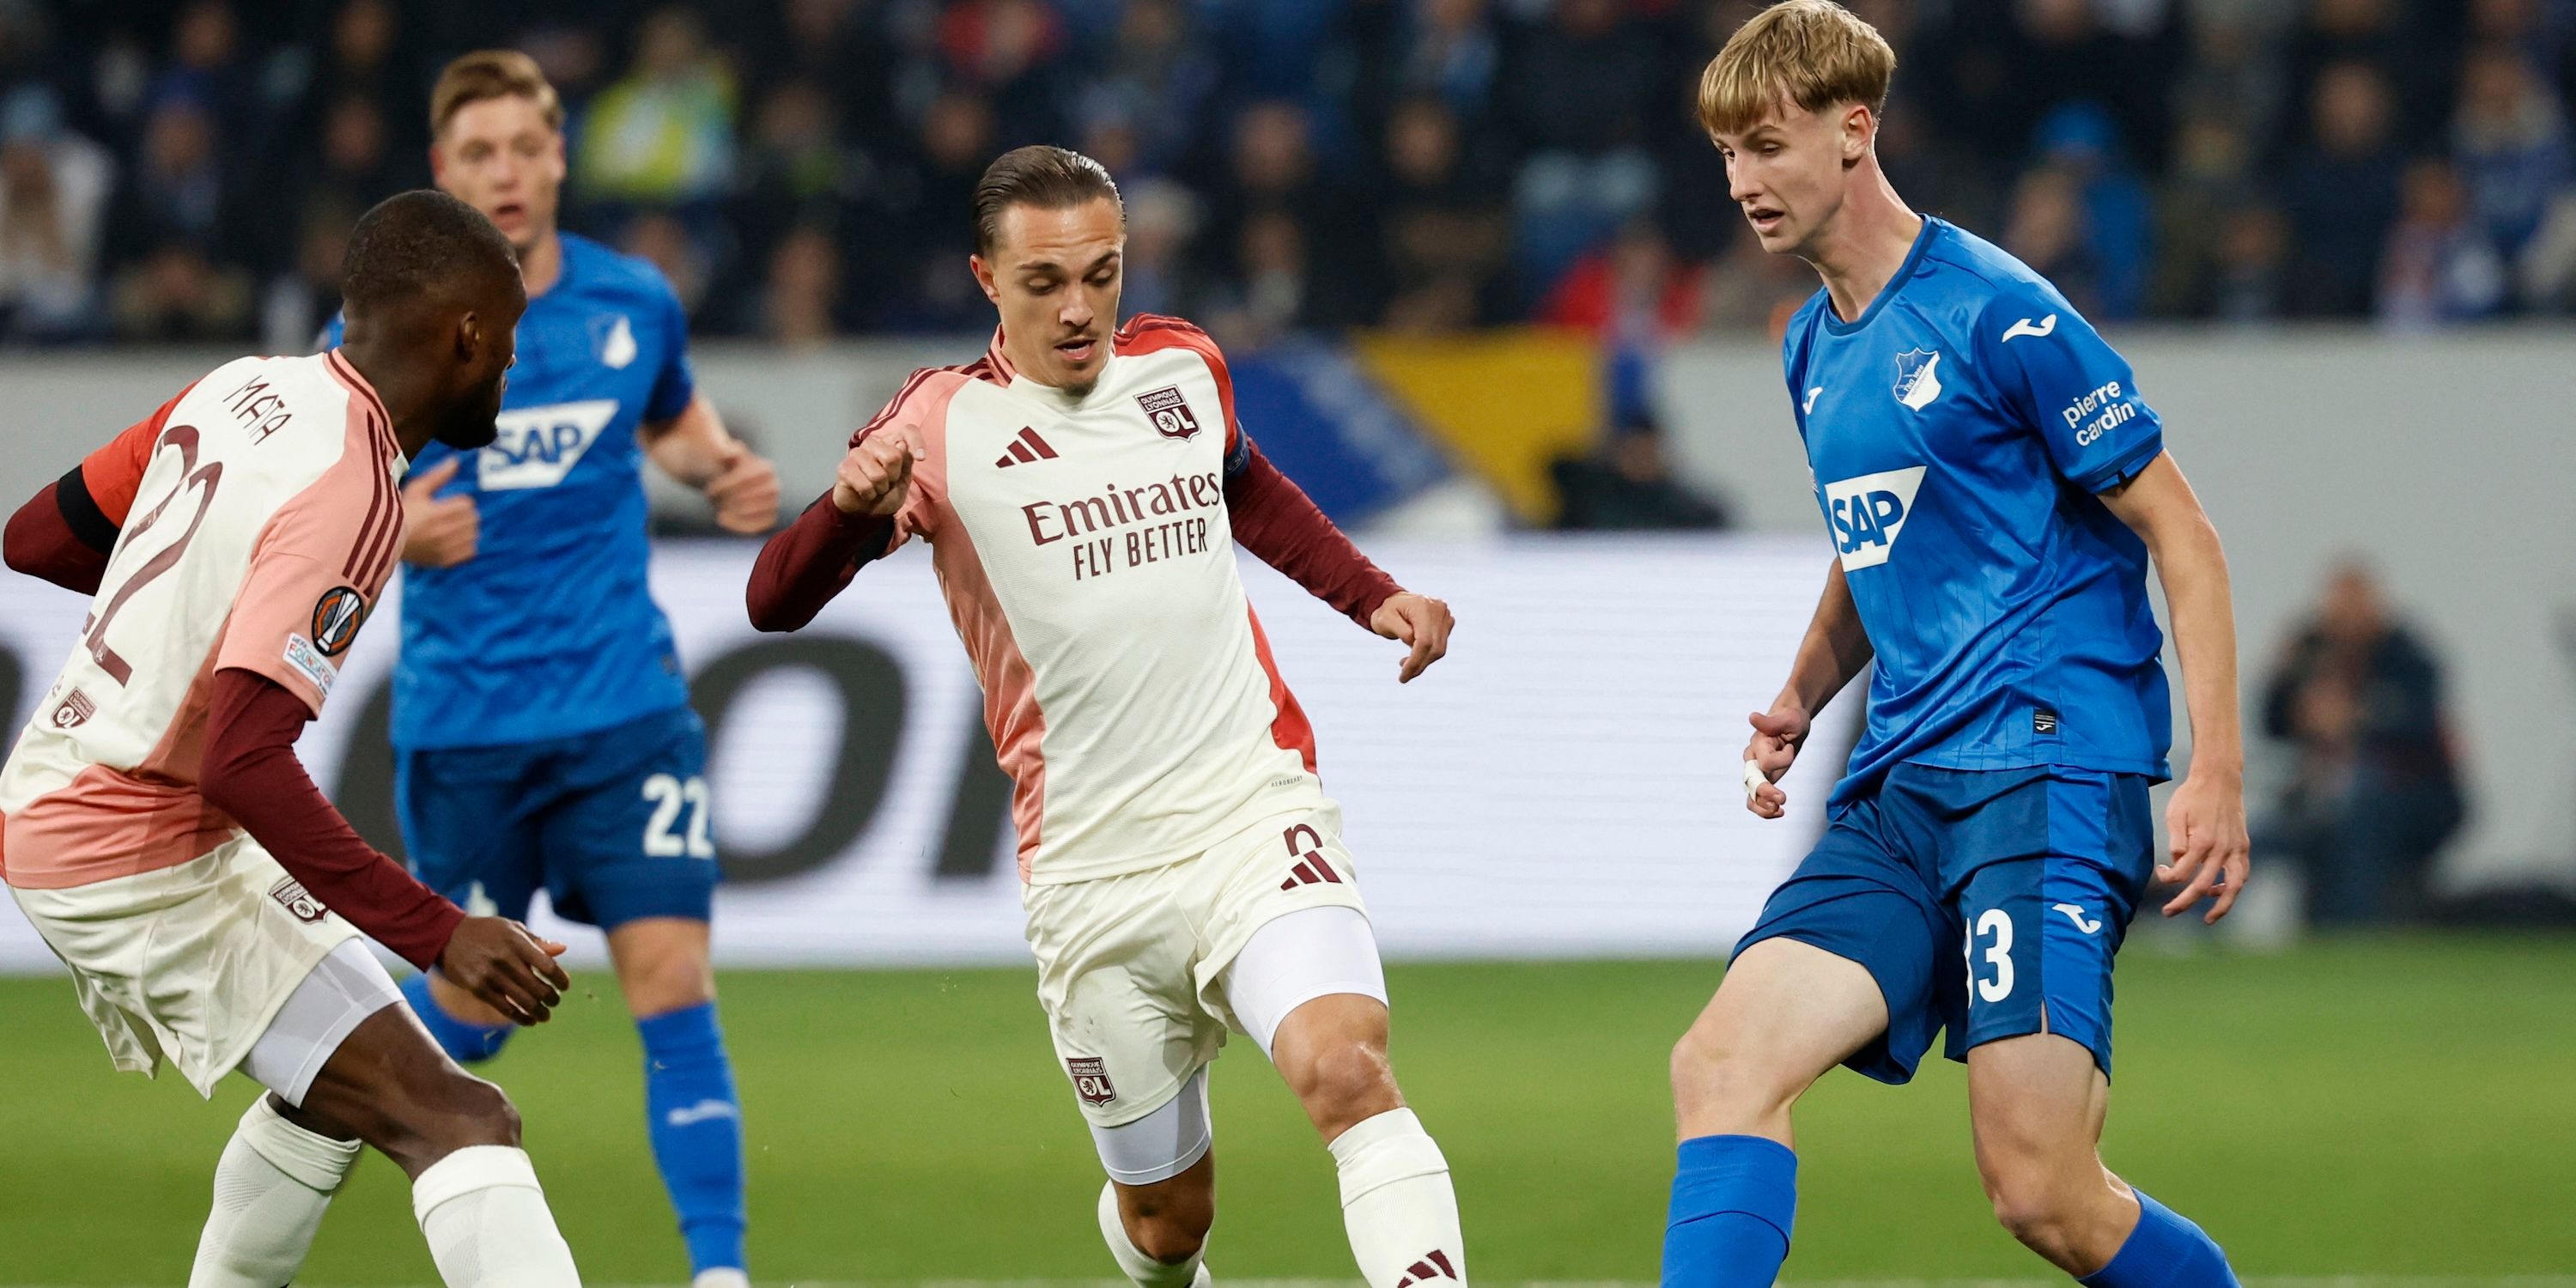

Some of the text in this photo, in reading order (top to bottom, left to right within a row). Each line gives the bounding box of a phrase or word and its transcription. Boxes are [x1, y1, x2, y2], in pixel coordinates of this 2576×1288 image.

[223, 374, 292, 446] MATA
[1140, 389, 1177, 404] OLYMPIQUE
[1145, 396, 1181, 410] LYONNAIS
[2062, 380, 2121, 429] pierre
[2075, 402, 2136, 447] cardin
[487, 424, 582, 471] SAP
[1020, 472, 1220, 546] Emirates
[1832, 490, 1905, 555] SAP
[1073, 517, 1207, 581] FLY BETTER
[641, 774, 715, 859] 22
